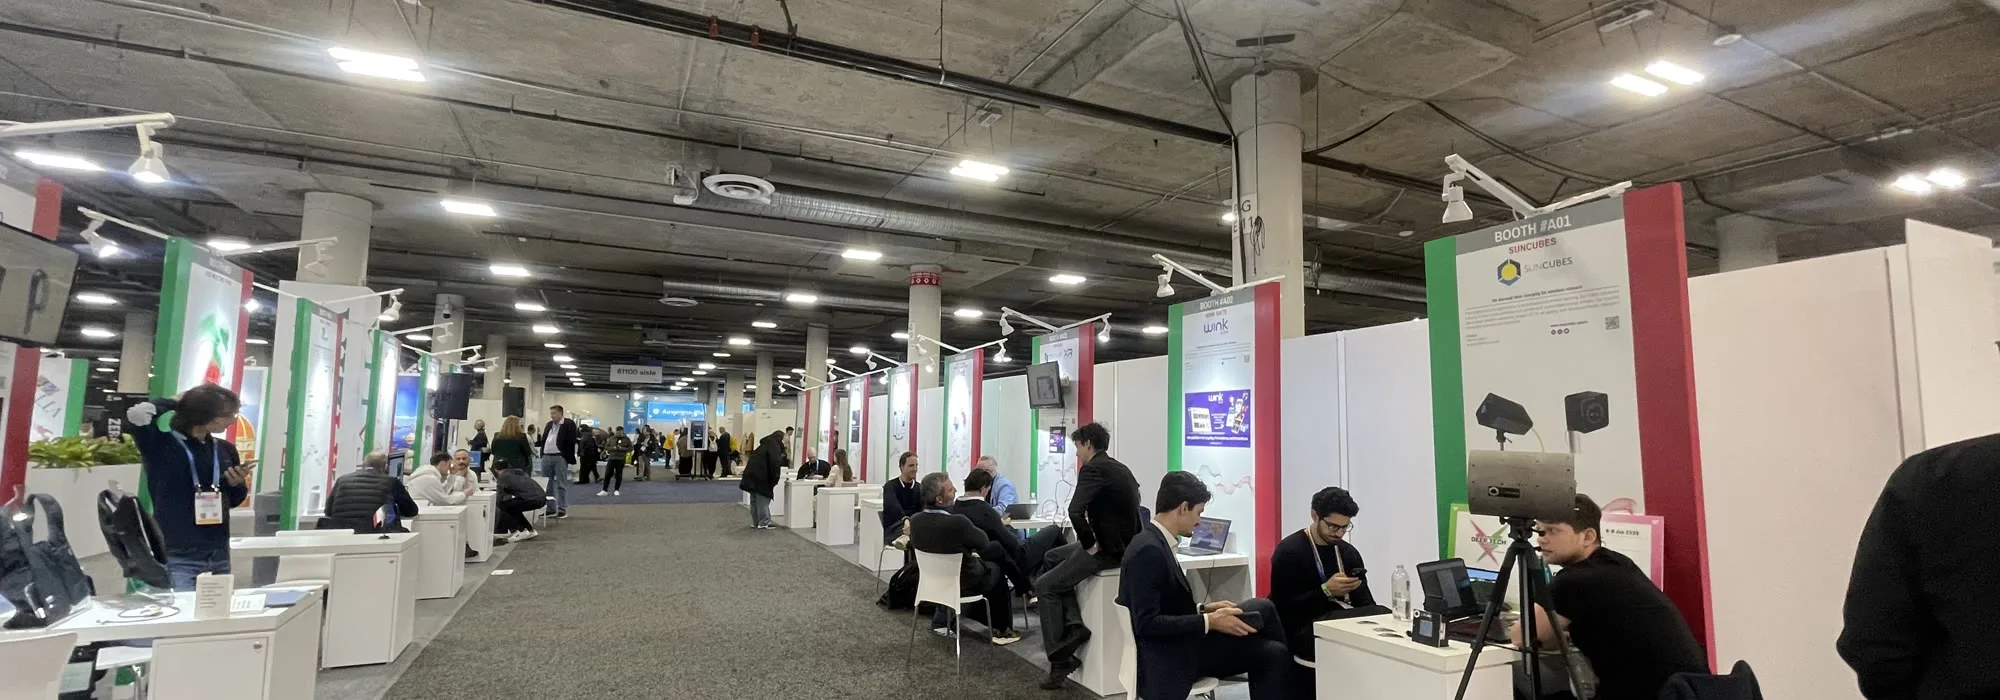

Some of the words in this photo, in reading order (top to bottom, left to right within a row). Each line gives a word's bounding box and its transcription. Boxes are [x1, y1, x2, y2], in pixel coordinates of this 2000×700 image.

[1494, 222, 1537, 243] BOOTH
[1540, 214, 1572, 233] #A01
[1508, 237, 1557, 255] SUNCUBES
[1200, 299, 1219, 310] BOOTH
[1203, 318, 1229, 334] wink
